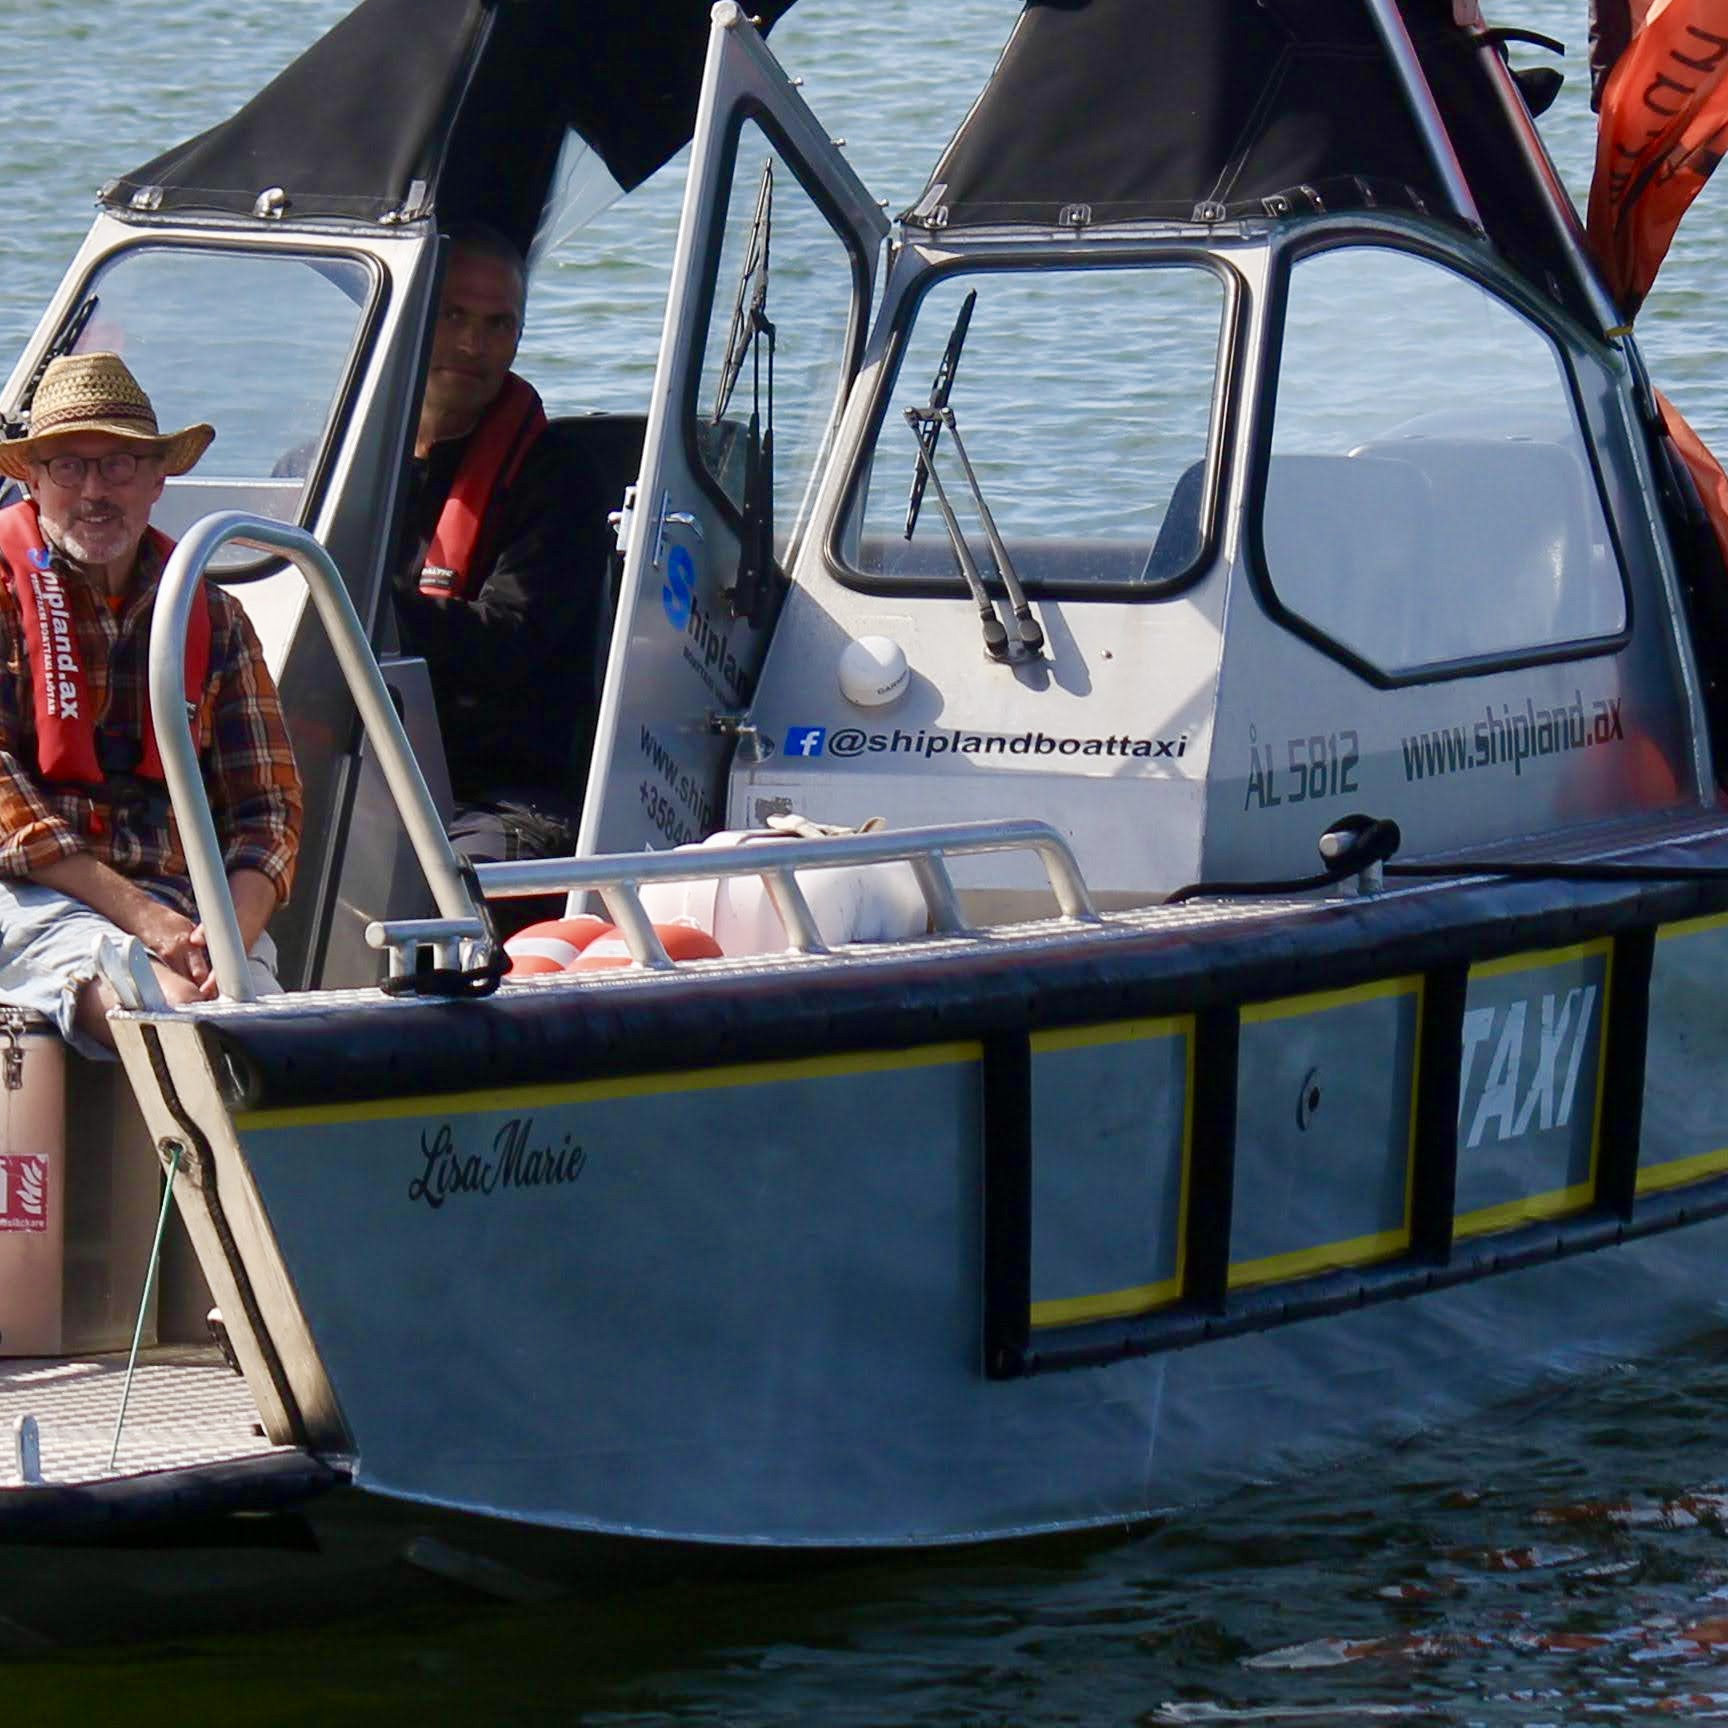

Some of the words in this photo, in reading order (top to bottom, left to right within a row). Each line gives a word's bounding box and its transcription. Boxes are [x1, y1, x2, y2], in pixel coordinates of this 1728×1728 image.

[827, 726, 1190, 760] @shiplandboattaxi
[1287, 729, 1360, 804] 5812
[1402, 688, 1625, 782] www.shipland.ax
[1459, 985, 1597, 1148] TAXI
